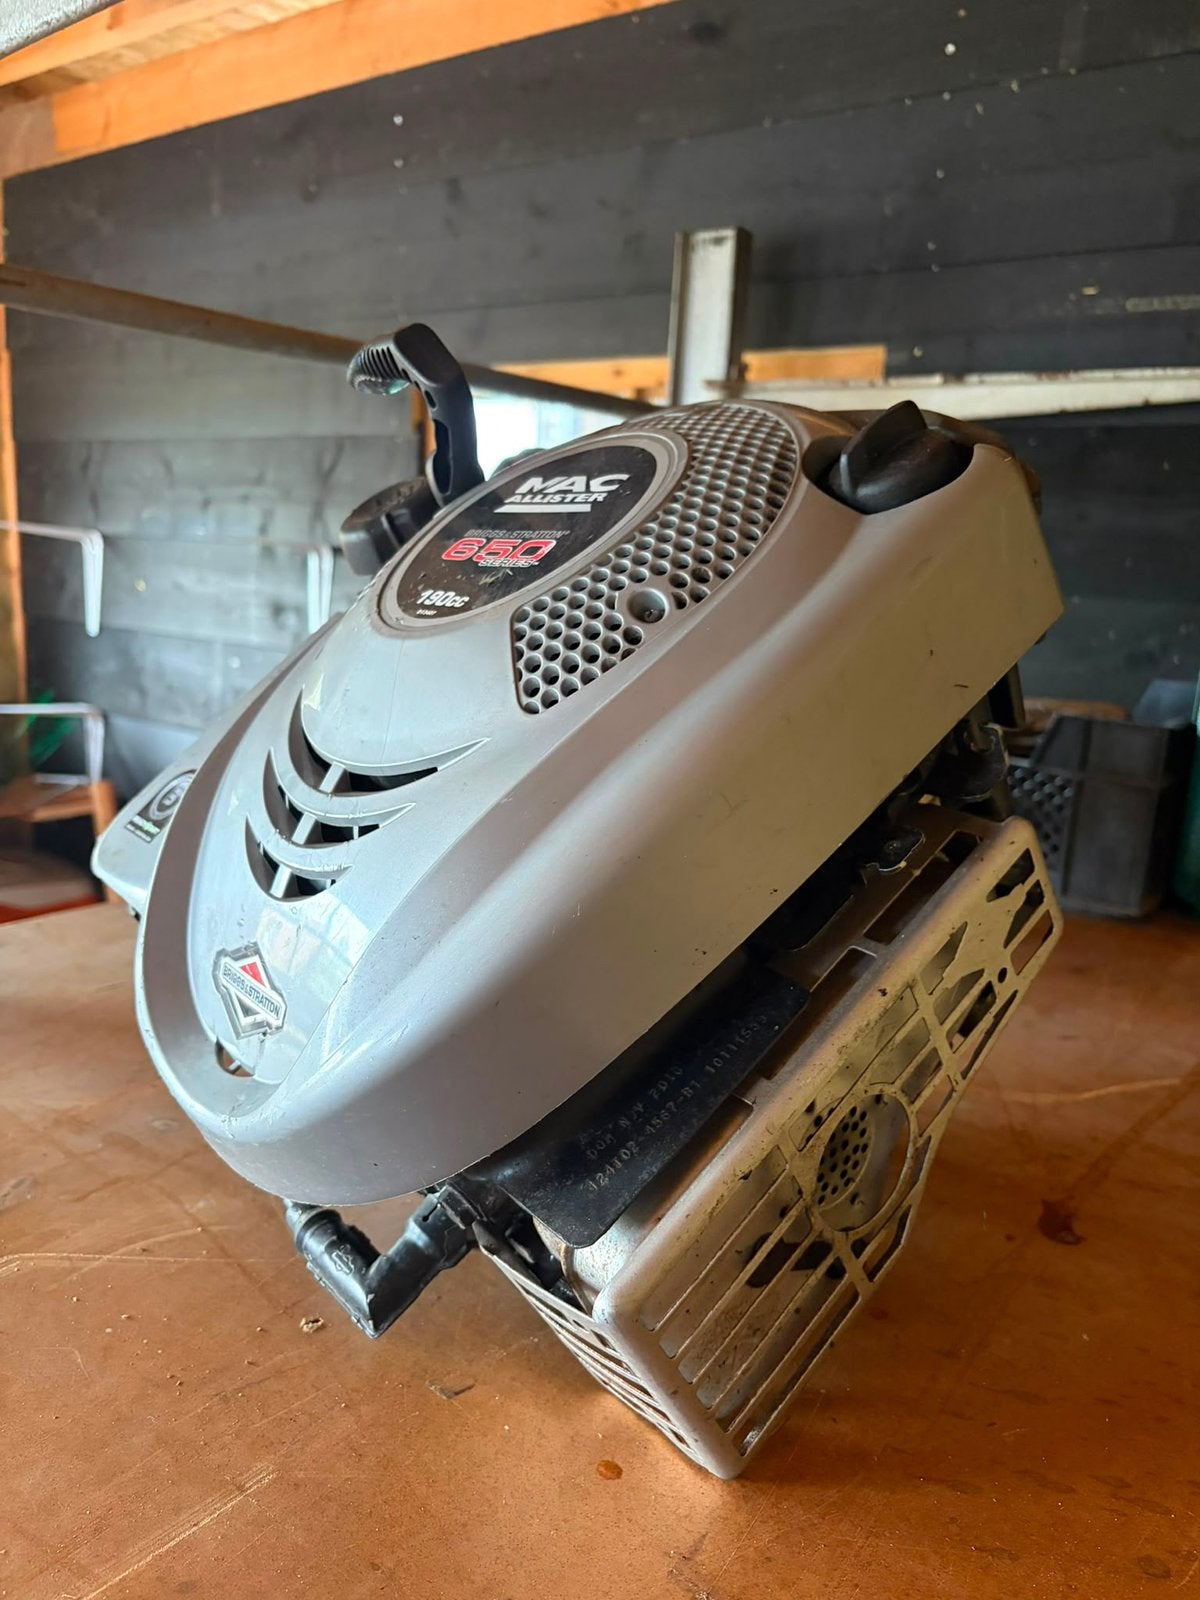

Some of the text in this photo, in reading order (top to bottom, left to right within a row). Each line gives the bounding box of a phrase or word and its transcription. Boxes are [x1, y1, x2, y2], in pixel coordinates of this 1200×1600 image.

[514, 473, 631, 494] MAC
[503, 492, 608, 503] ALLISTER
[441, 537, 557, 562] 650
[478, 558, 535, 567] SERIES
[416, 589, 470, 607] 190cc
[222, 964, 281, 1018] BRIGGS&STRATTON
